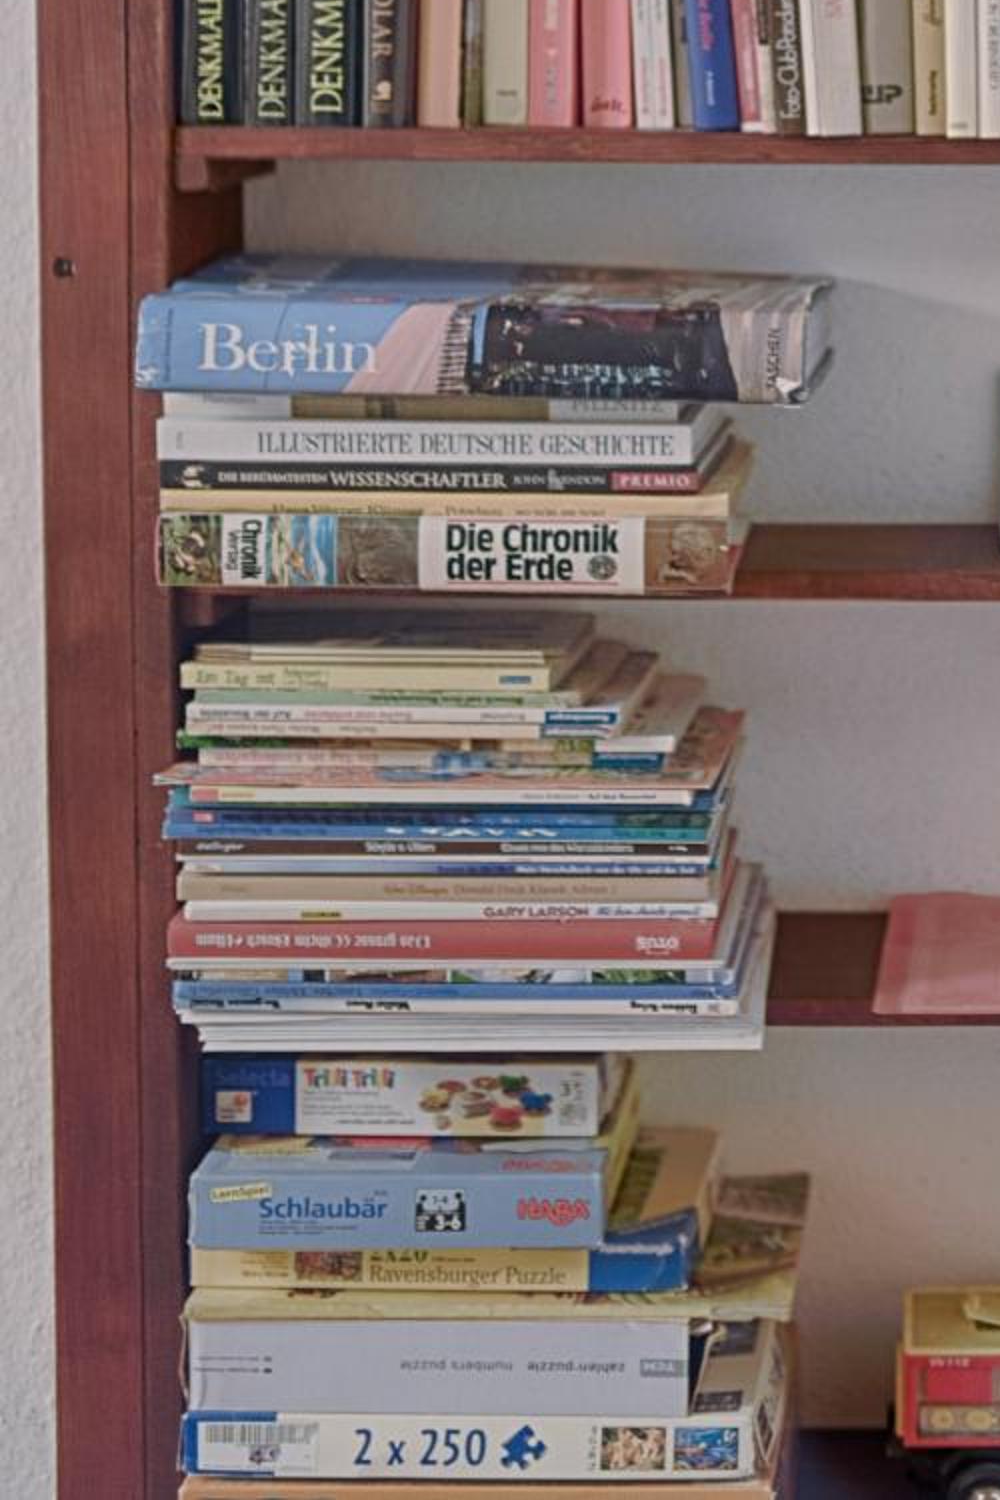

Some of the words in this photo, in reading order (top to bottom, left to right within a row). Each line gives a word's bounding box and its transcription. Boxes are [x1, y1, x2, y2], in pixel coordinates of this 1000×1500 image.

[196, 322, 380, 379] Berlin
[257, 430, 413, 455] ILLUSTRIERTE
[418, 432, 535, 456] DEUTSCHE
[540, 434, 675, 457] GESCHICHTE
[329, 471, 509, 489] WISSENSCHAFTLER
[620, 473, 690, 488] PREMIO
[446, 521, 494, 553] Die
[502, 521, 619, 553] Chronik
[240, 519, 263, 580] Chronik
[446, 553, 498, 581] der
[505, 553, 574, 581] Erde
[483, 906, 524, 918] GARY
[528, 906, 590, 918] LARSON
[258, 1196, 388, 1219] Schlaubär
[368, 1265, 500, 1287] Ravensburger
[505, 1266, 567, 1286] Puzzle
[399, 1359, 448, 1373] puzzle
[450, 1360, 513, 1373] numbers
[353, 1427, 373, 1466] 2
[387, 1438, 407, 1466] x
[420, 1427, 487, 1466] 250
